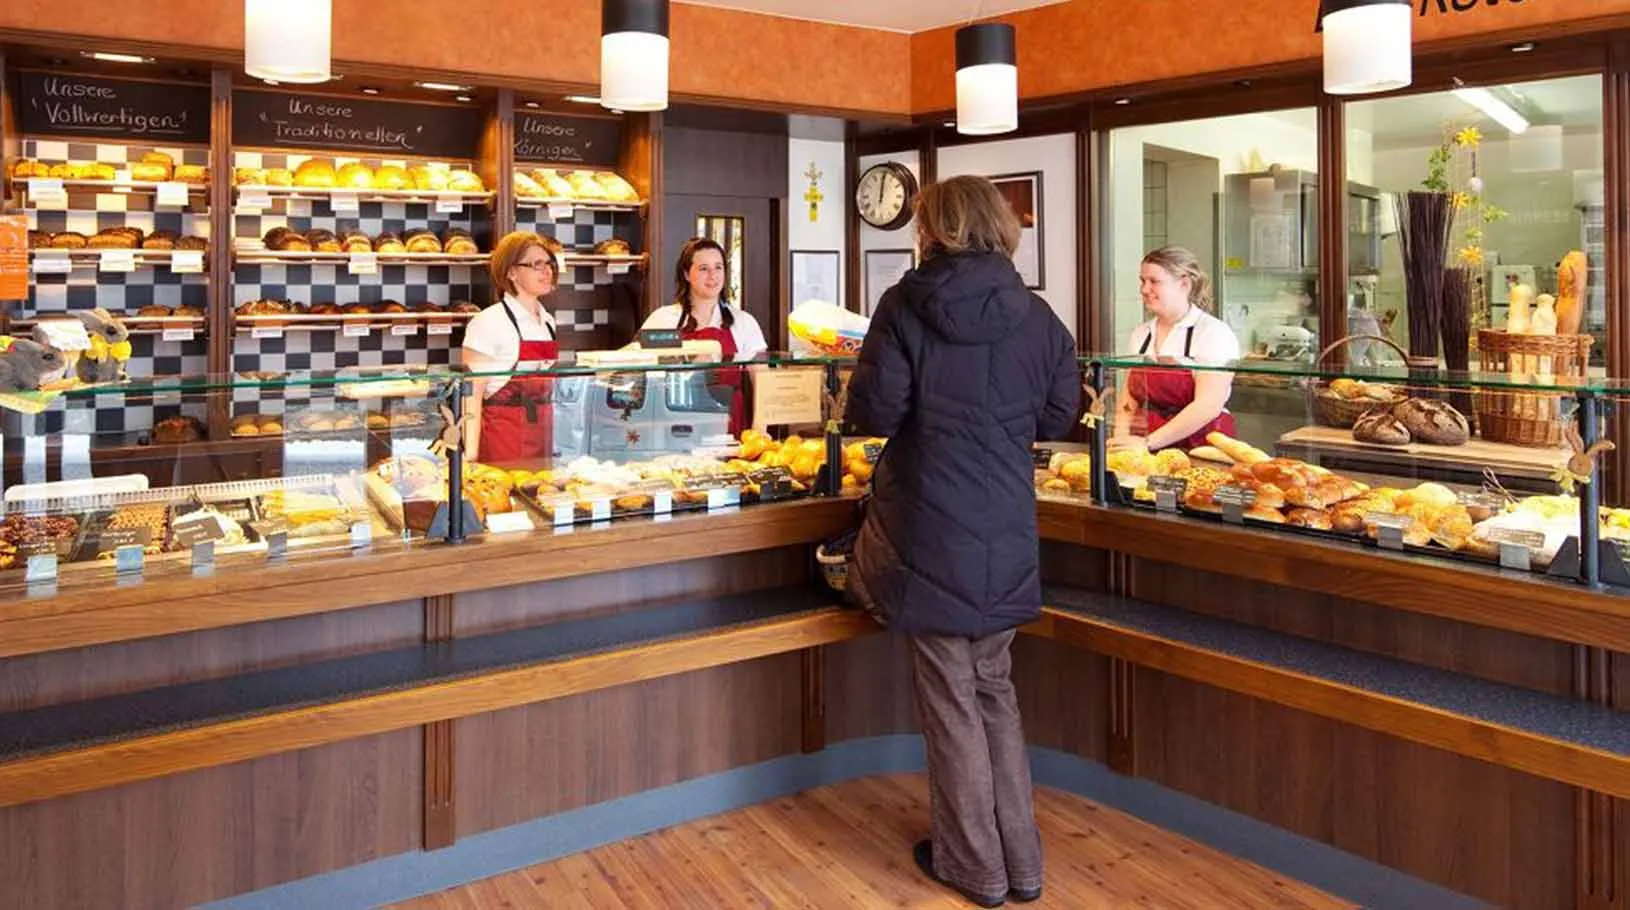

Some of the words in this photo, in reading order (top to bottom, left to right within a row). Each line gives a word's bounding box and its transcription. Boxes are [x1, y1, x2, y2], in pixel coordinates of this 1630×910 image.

[43, 77, 117, 98] Unsere
[288, 97, 353, 118] Unsere
[522, 117, 576, 137] Unsere
